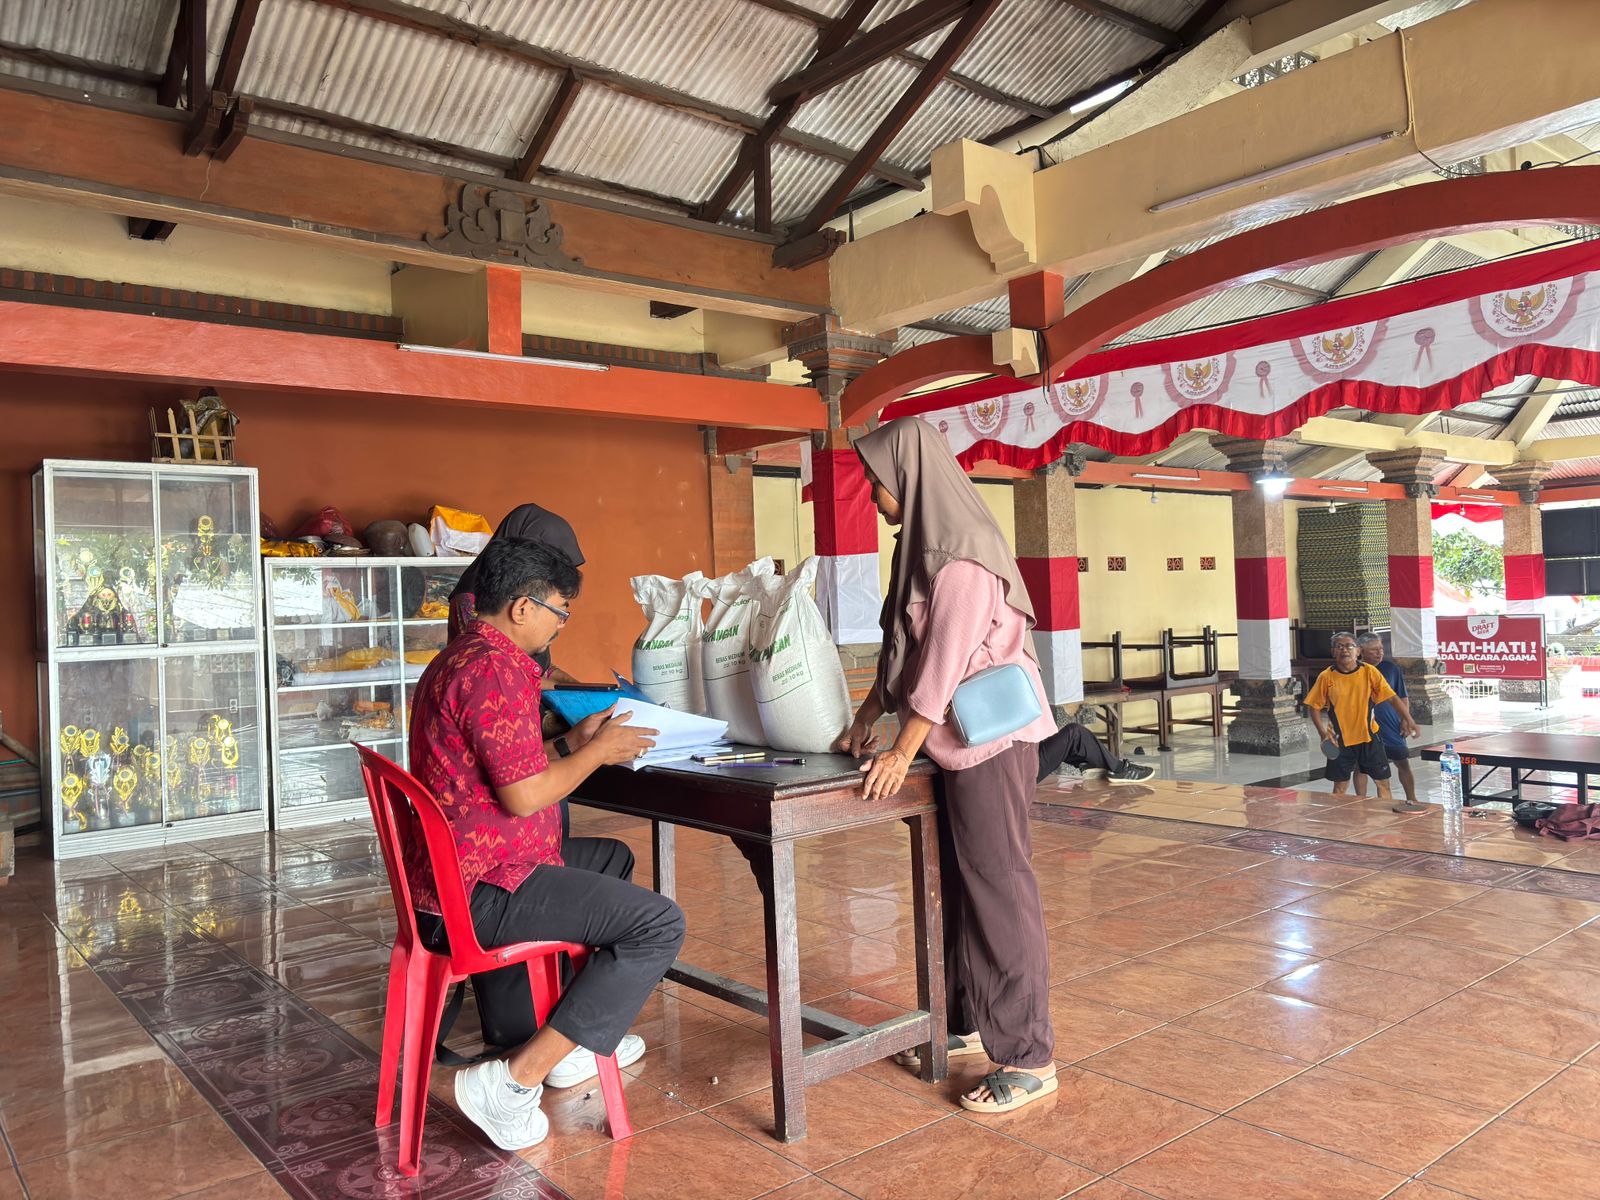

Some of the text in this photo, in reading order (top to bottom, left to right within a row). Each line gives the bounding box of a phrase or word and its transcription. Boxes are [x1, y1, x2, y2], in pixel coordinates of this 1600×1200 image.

[1471, 622, 1494, 632] DRAFT
[1437, 641, 1537, 654] HATI-HATI !
